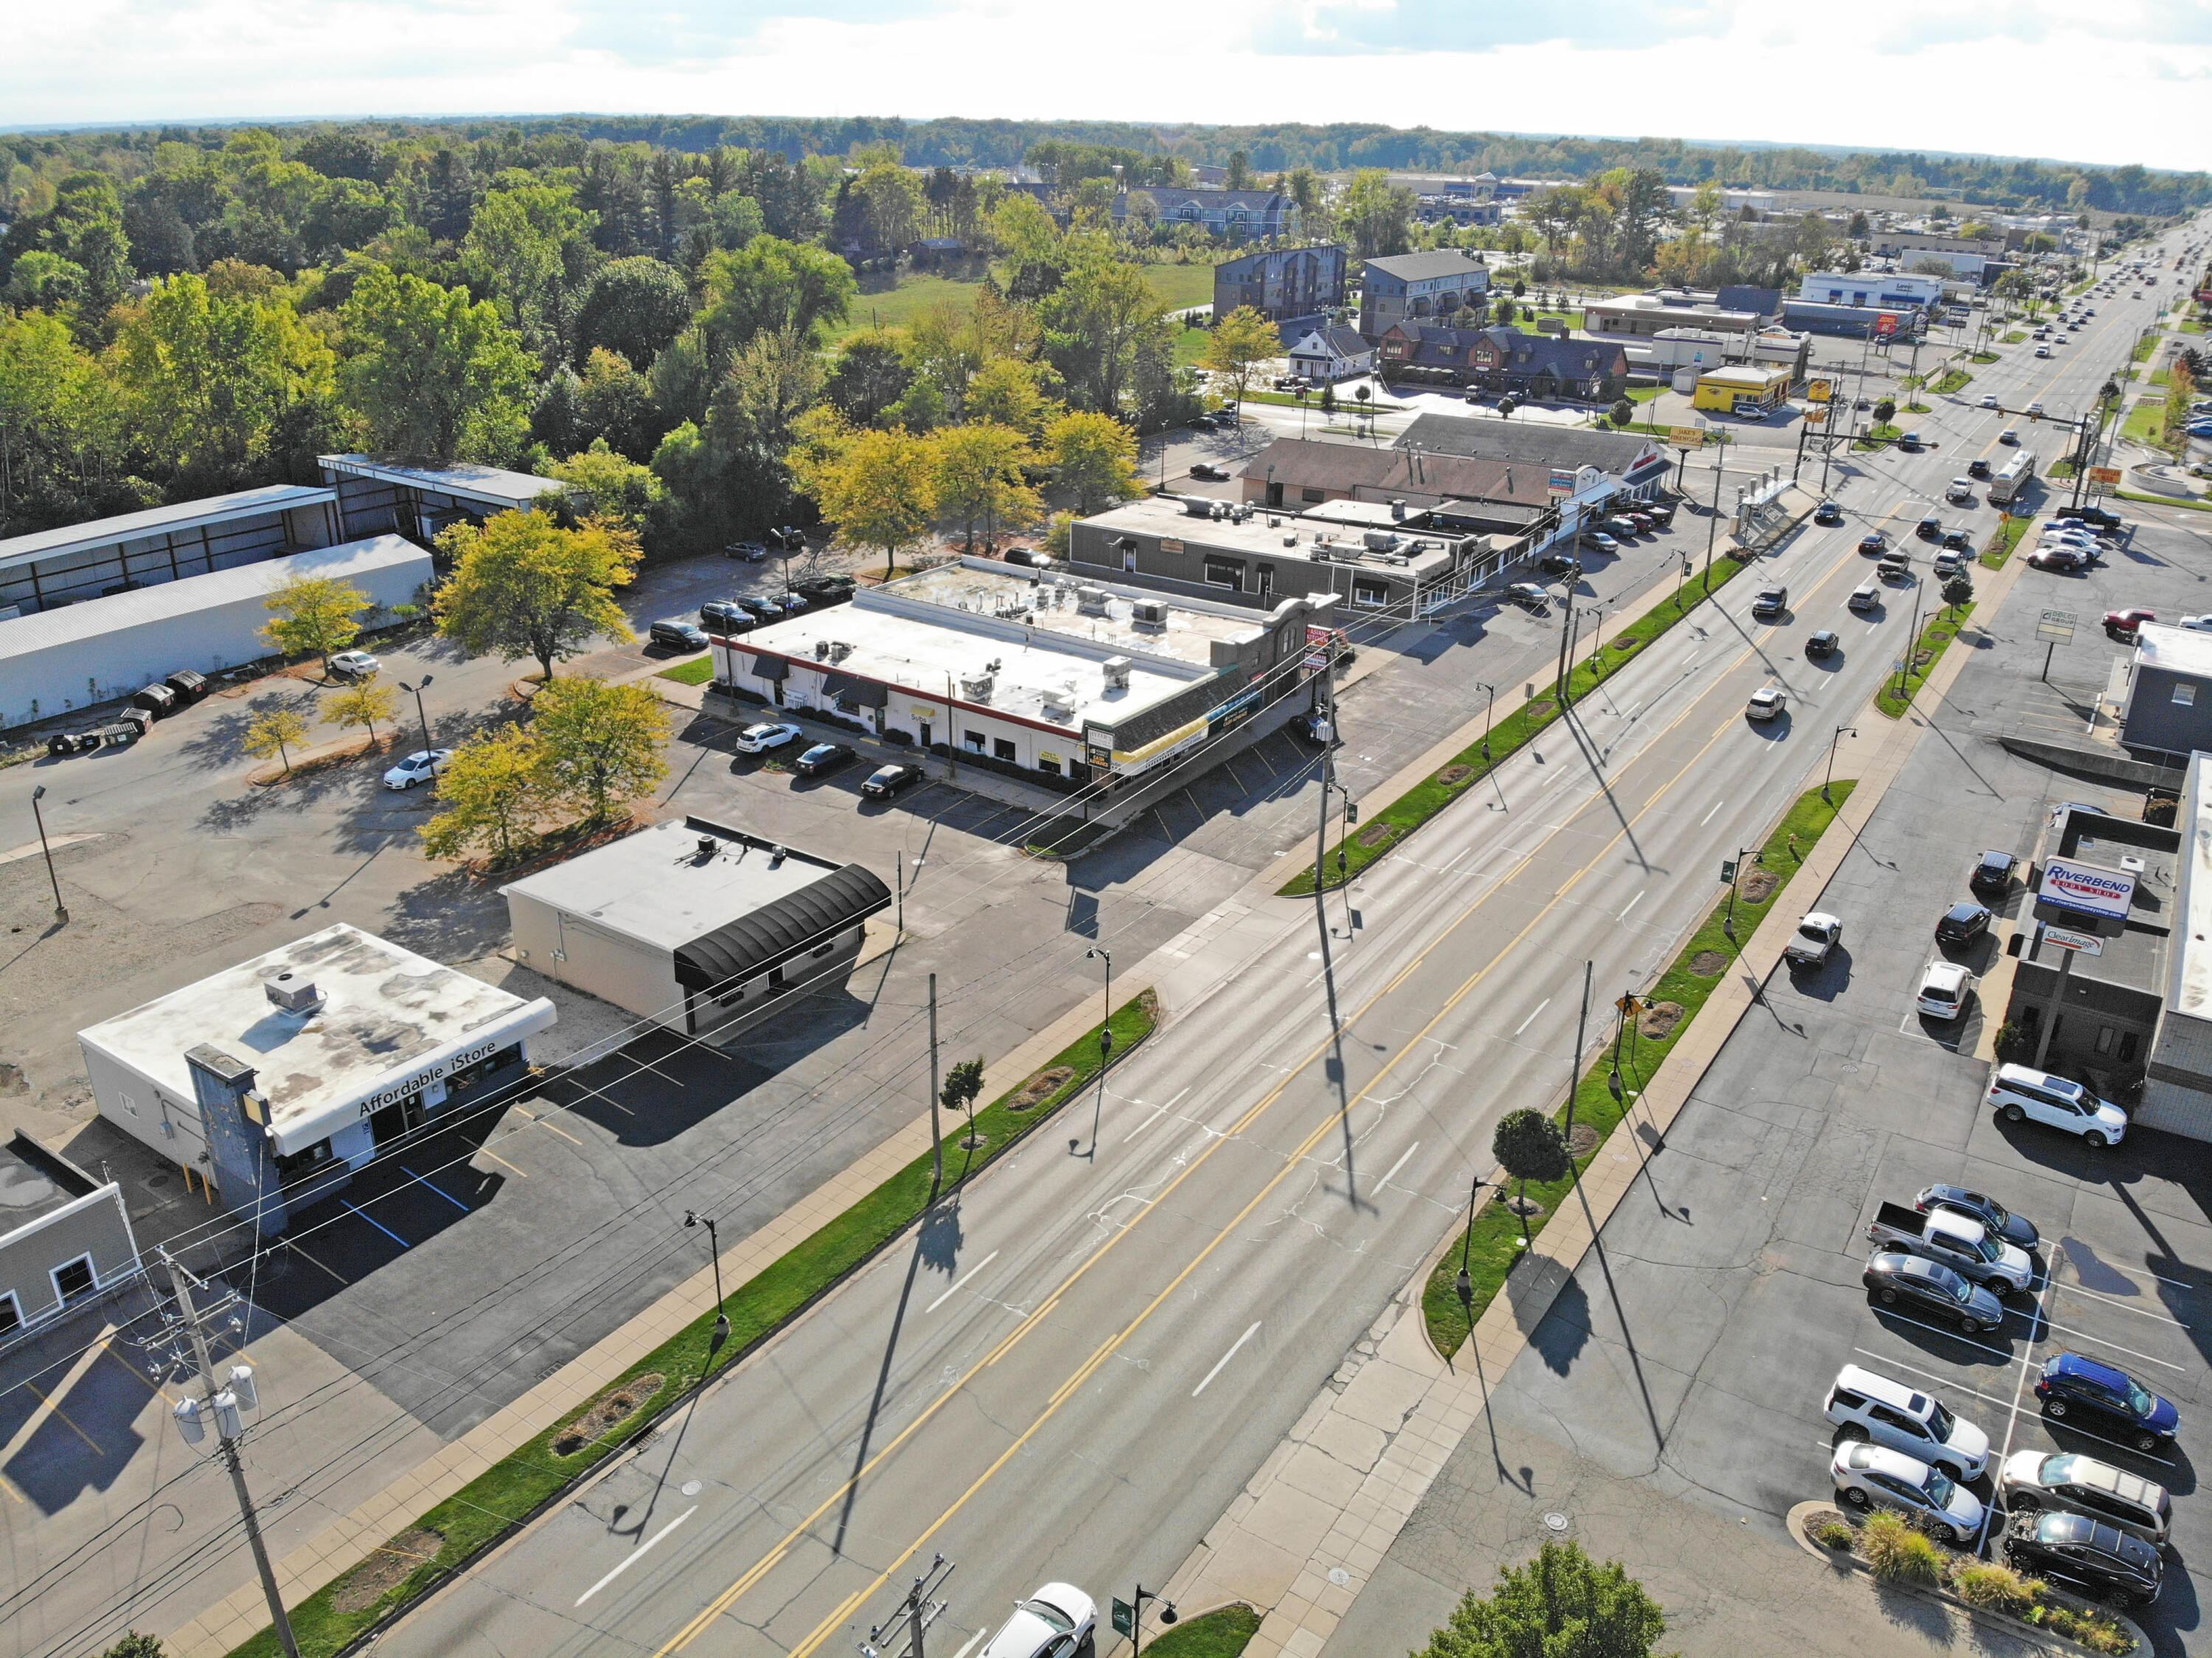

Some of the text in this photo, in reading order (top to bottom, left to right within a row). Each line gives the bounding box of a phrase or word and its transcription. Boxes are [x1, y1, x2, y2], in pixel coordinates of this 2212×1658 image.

[1678, 429, 1696, 437] JAKE'S
[1670, 434, 1703, 443] FIREWORKS
[2053, 611, 2075, 620] DOLCI
[1310, 628, 1326, 637] ASIAN
[1307, 634, 1329, 642] KITCHEN
[911, 713, 927, 724] Subs
[2047, 865, 2131, 892] RIVERBEND
[2056, 879, 2118, 898] BODY SHOP
[2042, 896, 2122, 918] www.riverbendbodyshop.com
[359, 1042, 495, 1117] Affordable iStore
